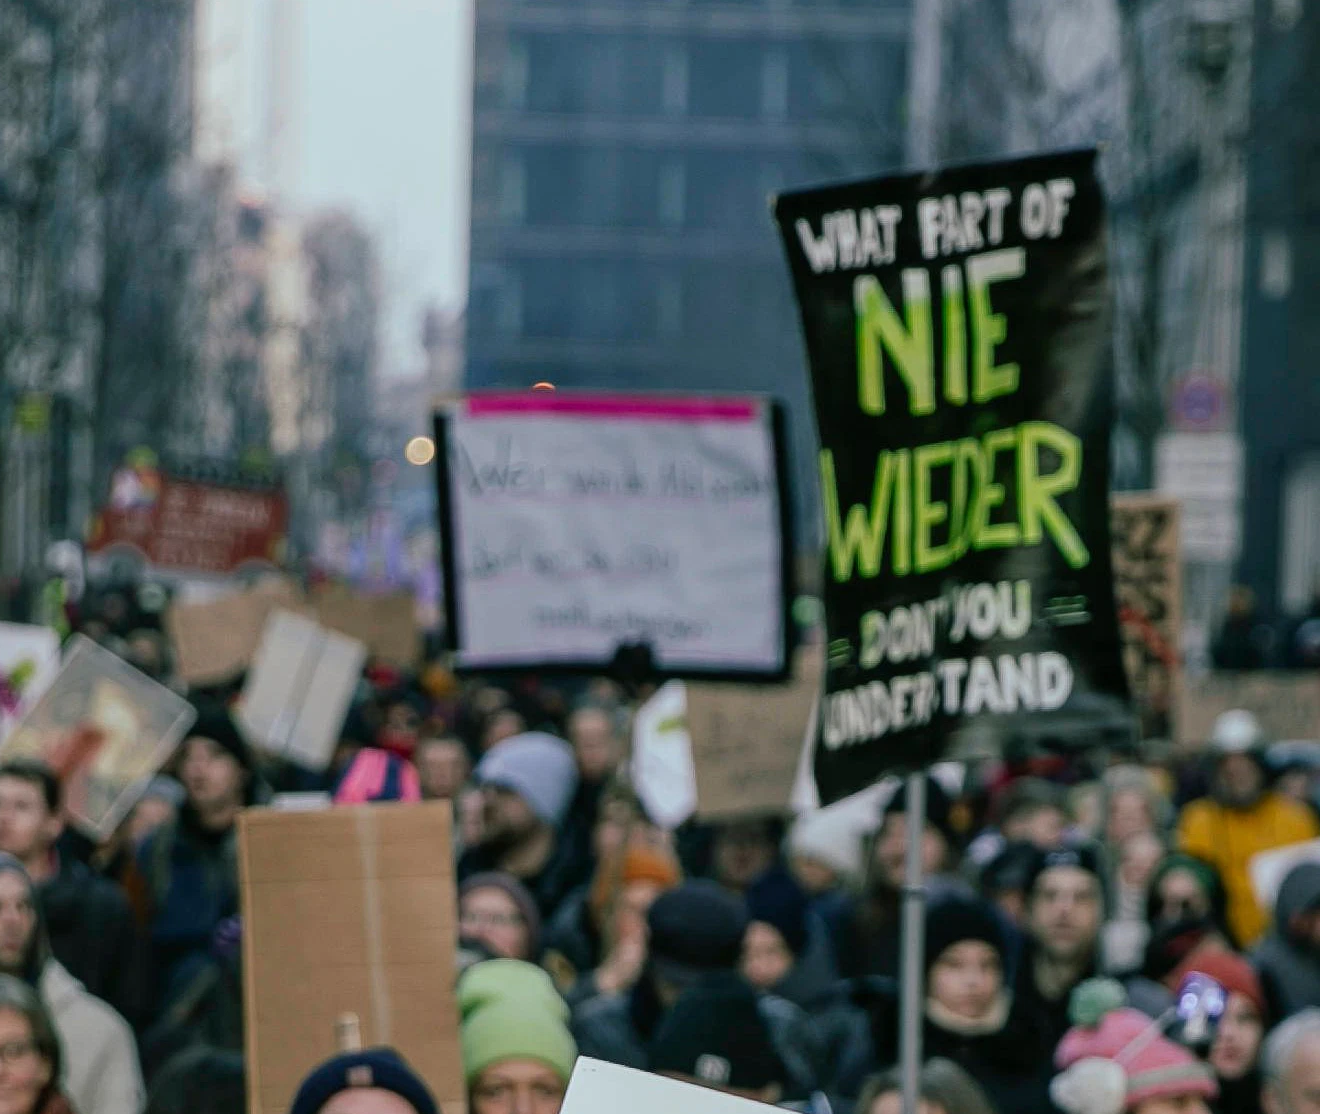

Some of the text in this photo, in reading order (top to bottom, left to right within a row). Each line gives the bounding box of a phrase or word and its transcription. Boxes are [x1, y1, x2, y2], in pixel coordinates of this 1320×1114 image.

[795, 176, 1076, 274] WHAT PART OF
[853, 245, 1027, 417] NIE
[820, 420, 1091, 583] WIEDER
[948, 579, 1032, 643] YOU
